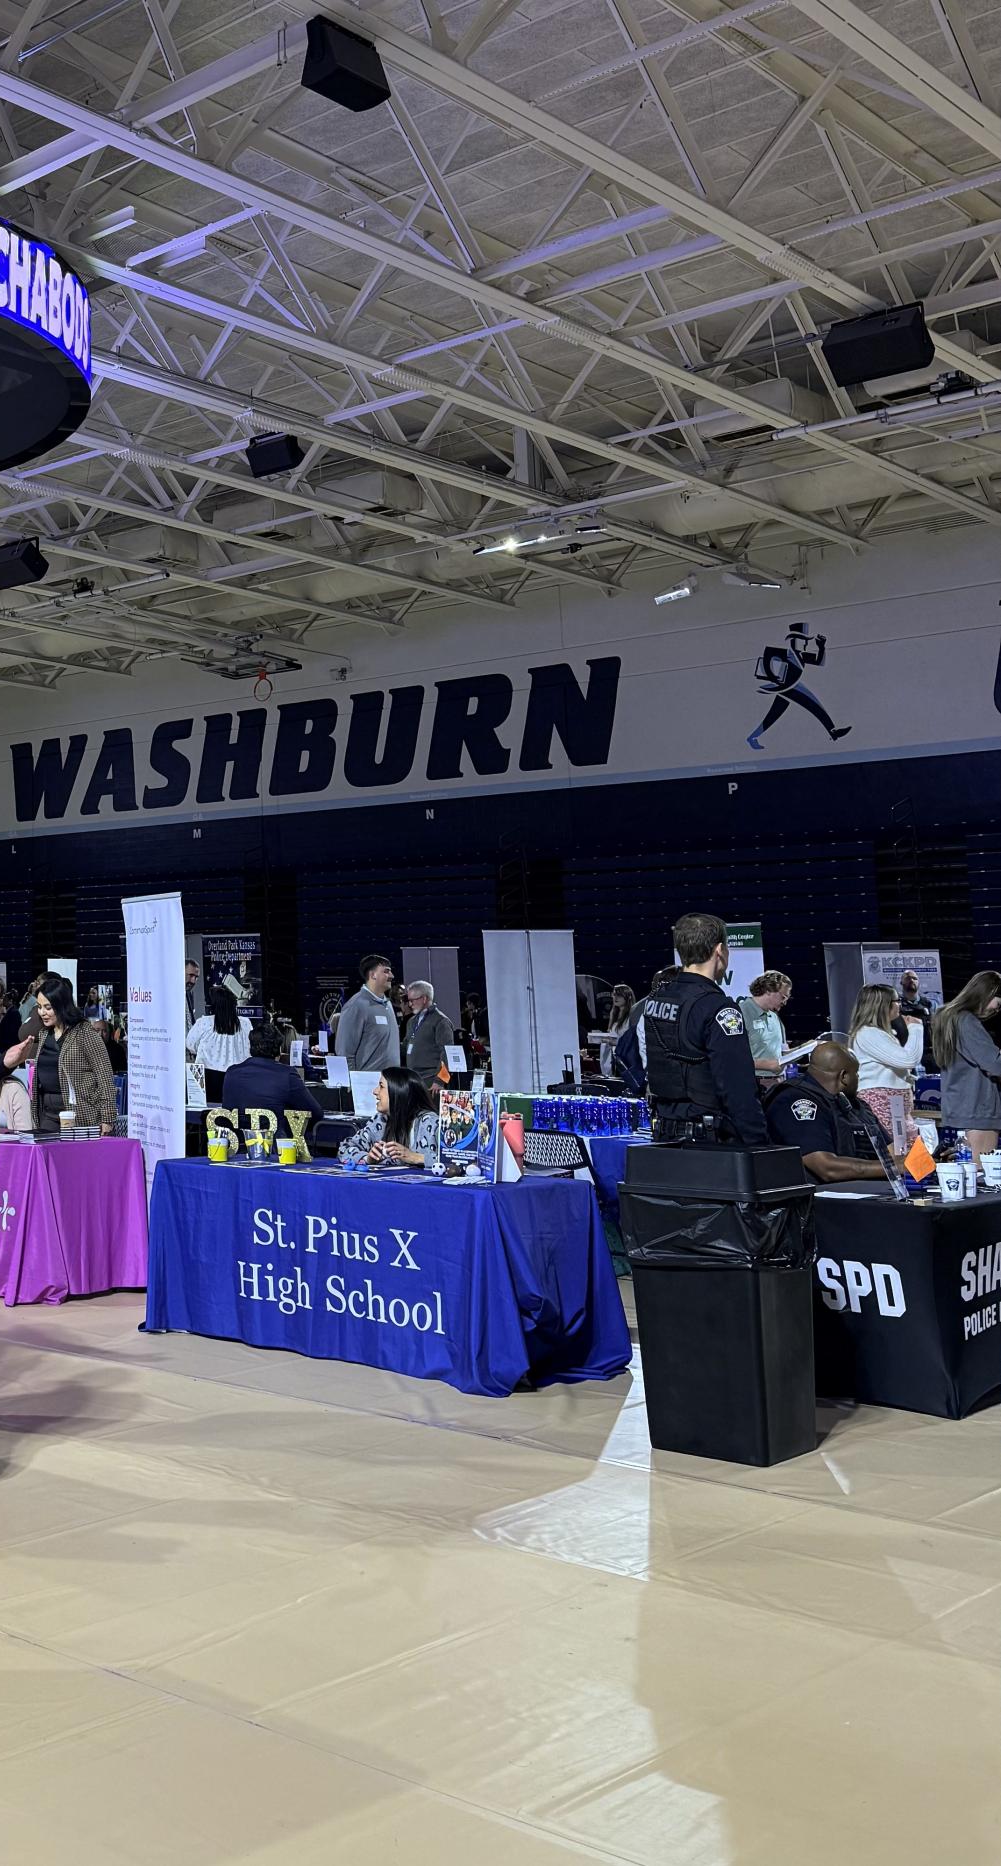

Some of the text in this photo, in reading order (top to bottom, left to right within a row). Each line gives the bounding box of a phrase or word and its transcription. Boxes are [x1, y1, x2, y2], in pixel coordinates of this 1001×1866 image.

[10, 656, 622, 823] WASHBURN
[727, 782, 739, 795] P
[426, 809, 434, 820] N
[192, 829, 202, 839] M
[11, 844, 17, 854] L
[207, 940, 256, 951] Overland Park Kansas
[881, 956, 937, 968] KCKPD
[129, 986, 152, 1003] Values
[252, 1207, 421, 1271] St. Pius X
[816, 1257, 907, 1318] SPD
[237, 1259, 446, 1335] High School
[963, 1303, 997, 1341] POLICE
